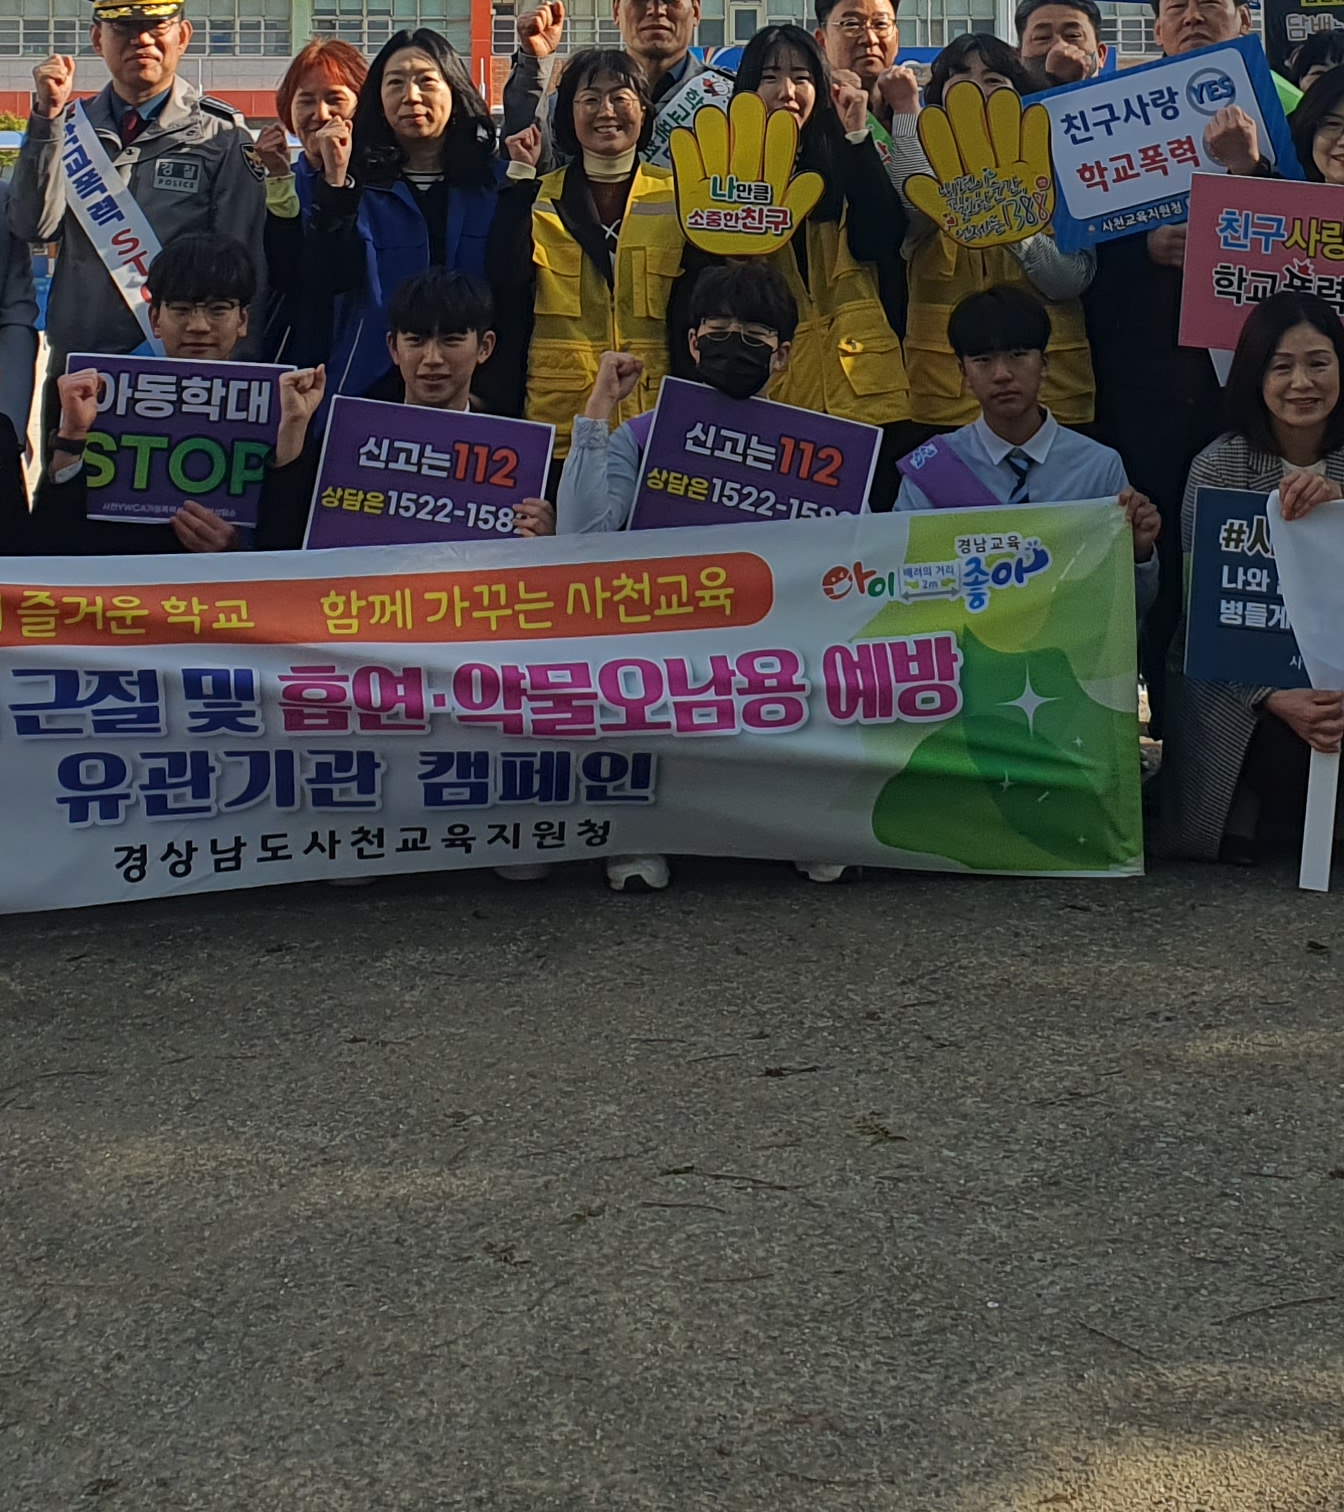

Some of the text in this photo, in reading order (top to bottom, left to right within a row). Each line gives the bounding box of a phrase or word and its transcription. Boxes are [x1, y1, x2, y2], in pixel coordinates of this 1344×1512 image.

[1059, 76, 1236, 146] 친구사랑 YES
[157, 177, 197, 190] POLICE
[160, 161, 197, 180] 경찰
[710, 175, 773, 204] 나만큼
[1076, 136, 1202, 192] 학교폭력
[1101, 201, 1184, 233] 사천교육지원청
[96, 371, 272, 425] 아동학대
[83, 430, 272, 496] STOP
[935, 564, 955, 576] 거리
[957, 535, 1022, 555] 경남교육
[16, 589, 150, 639] 즐거운
[162, 596, 256, 634] 학교
[319, 589, 413, 634] 함께
[425, 579, 556, 631] 가꾸는
[566, 566, 735, 622] 사천교육
[1221, 564, 1272, 594] 나와
[8, 665, 160, 737] 근절
[182, 666, 261, 736] 및
[821, 631, 963, 723] 예방
[56, 746, 657, 826] 유관기관 캠페인
[113, 817, 613, 884] 경상남도사천교육지원청
